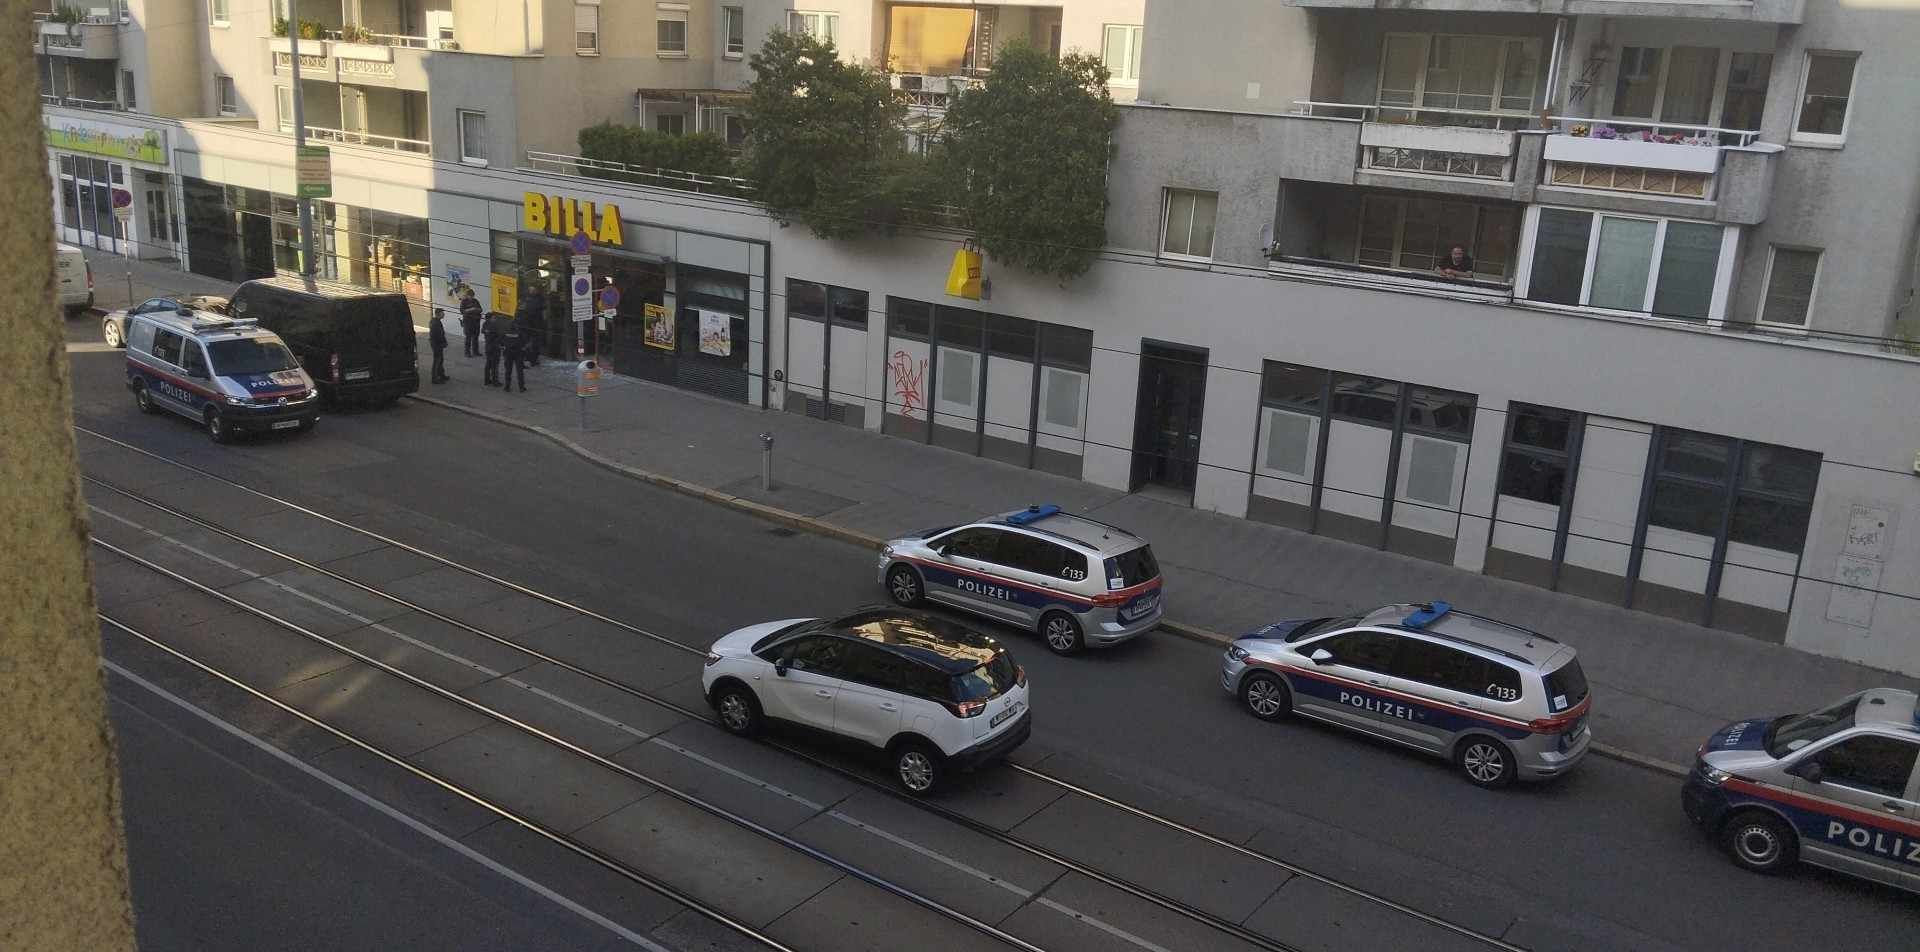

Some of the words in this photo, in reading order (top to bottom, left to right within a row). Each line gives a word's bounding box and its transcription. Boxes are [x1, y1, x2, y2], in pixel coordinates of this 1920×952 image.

[523, 191, 624, 246] BILLA
[160, 381, 192, 403] POLIZEI
[1069, 569, 1084, 581] 133
[957, 578, 1010, 601] POLIZEI
[1340, 691, 1413, 720] POLIZEI
[1497, 687, 1517, 701] 133
[1827, 820, 1920, 863] POLIZ
